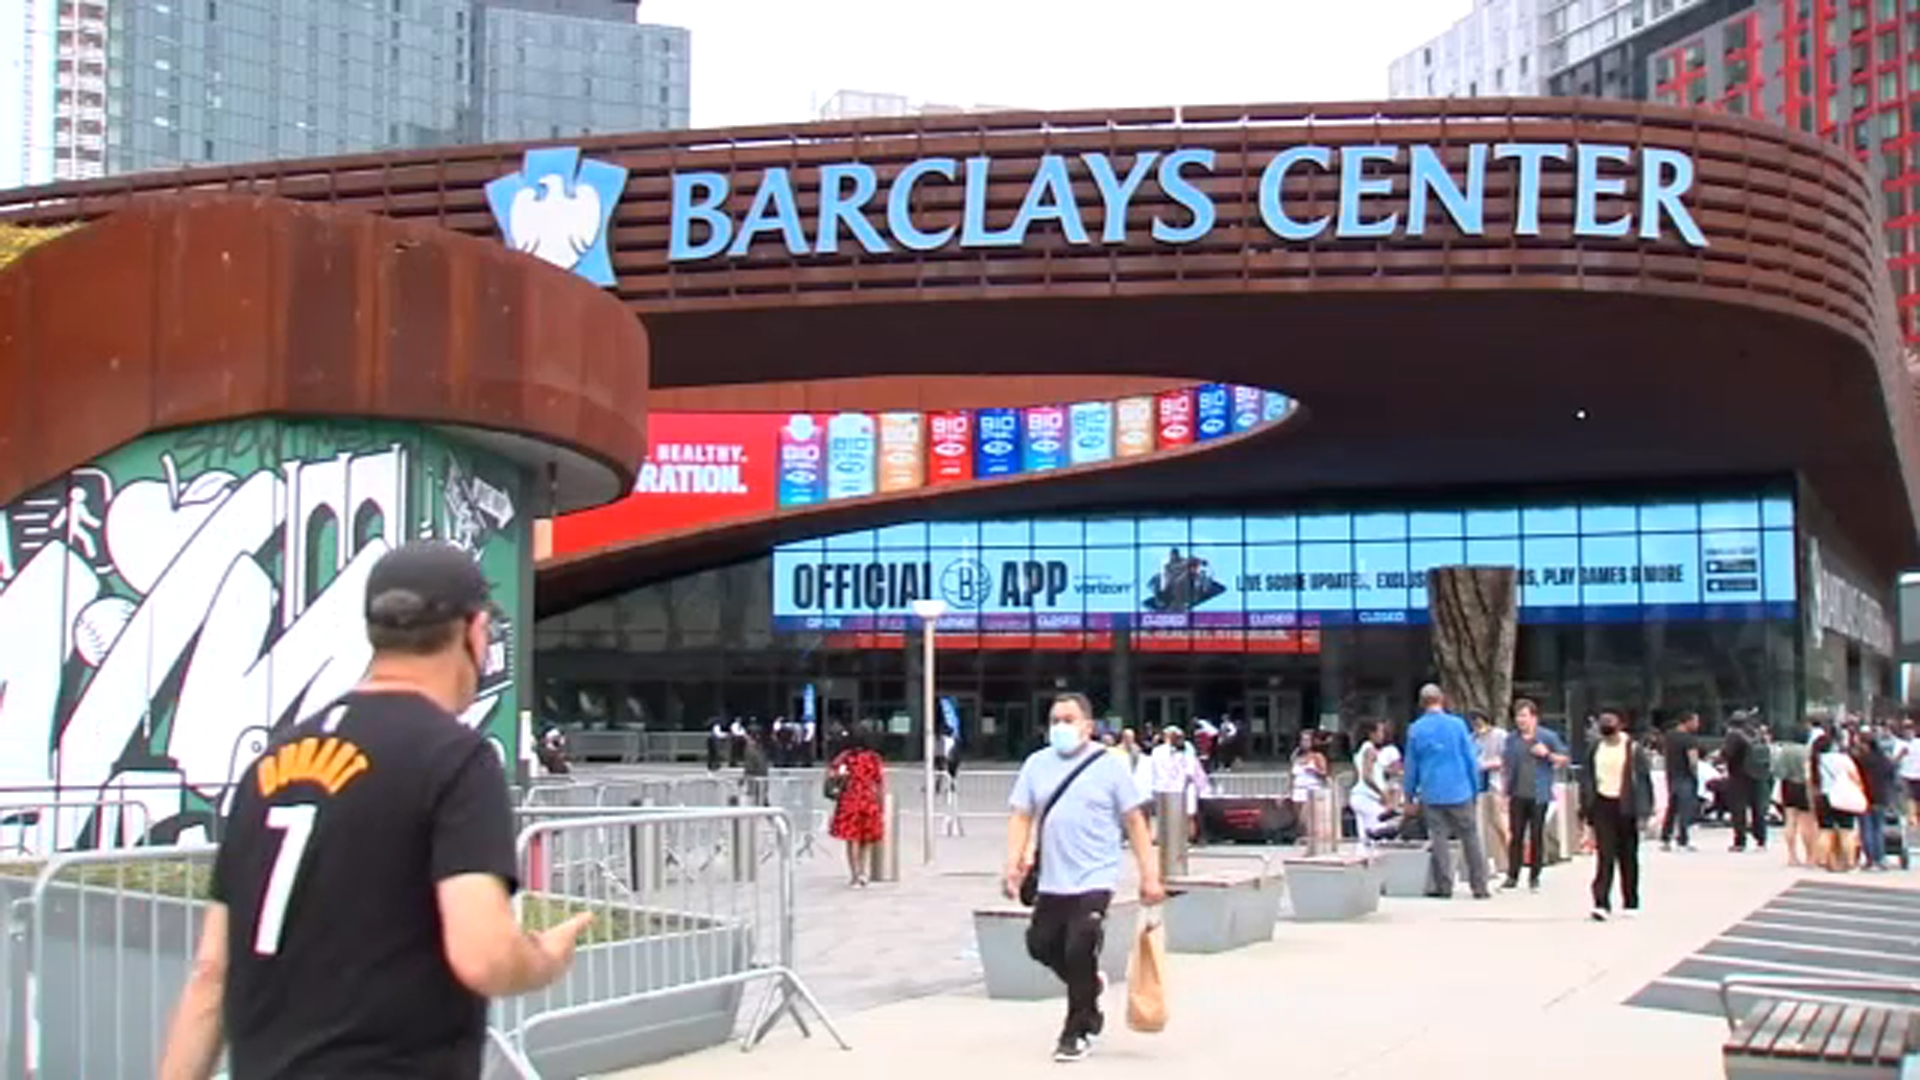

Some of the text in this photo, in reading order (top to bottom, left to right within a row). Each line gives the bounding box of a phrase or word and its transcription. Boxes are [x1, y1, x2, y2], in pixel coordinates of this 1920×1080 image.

[668, 143, 1710, 262] BARCLAYS CENTER
[657, 443, 748, 463] HEALTHY.
[792, 561, 932, 610] OFFICIAL
[999, 560, 1069, 608] APP
[1073, 582, 1131, 595] verizon
[1236, 575, 1262, 592] LIVE
[1265, 573, 1305, 591] SCORE
[1543, 567, 1576, 586] PLAY
[1578, 565, 1627, 585] GAMES
[1644, 564, 1684, 583] MORE
[254, 803, 318, 955] 7
